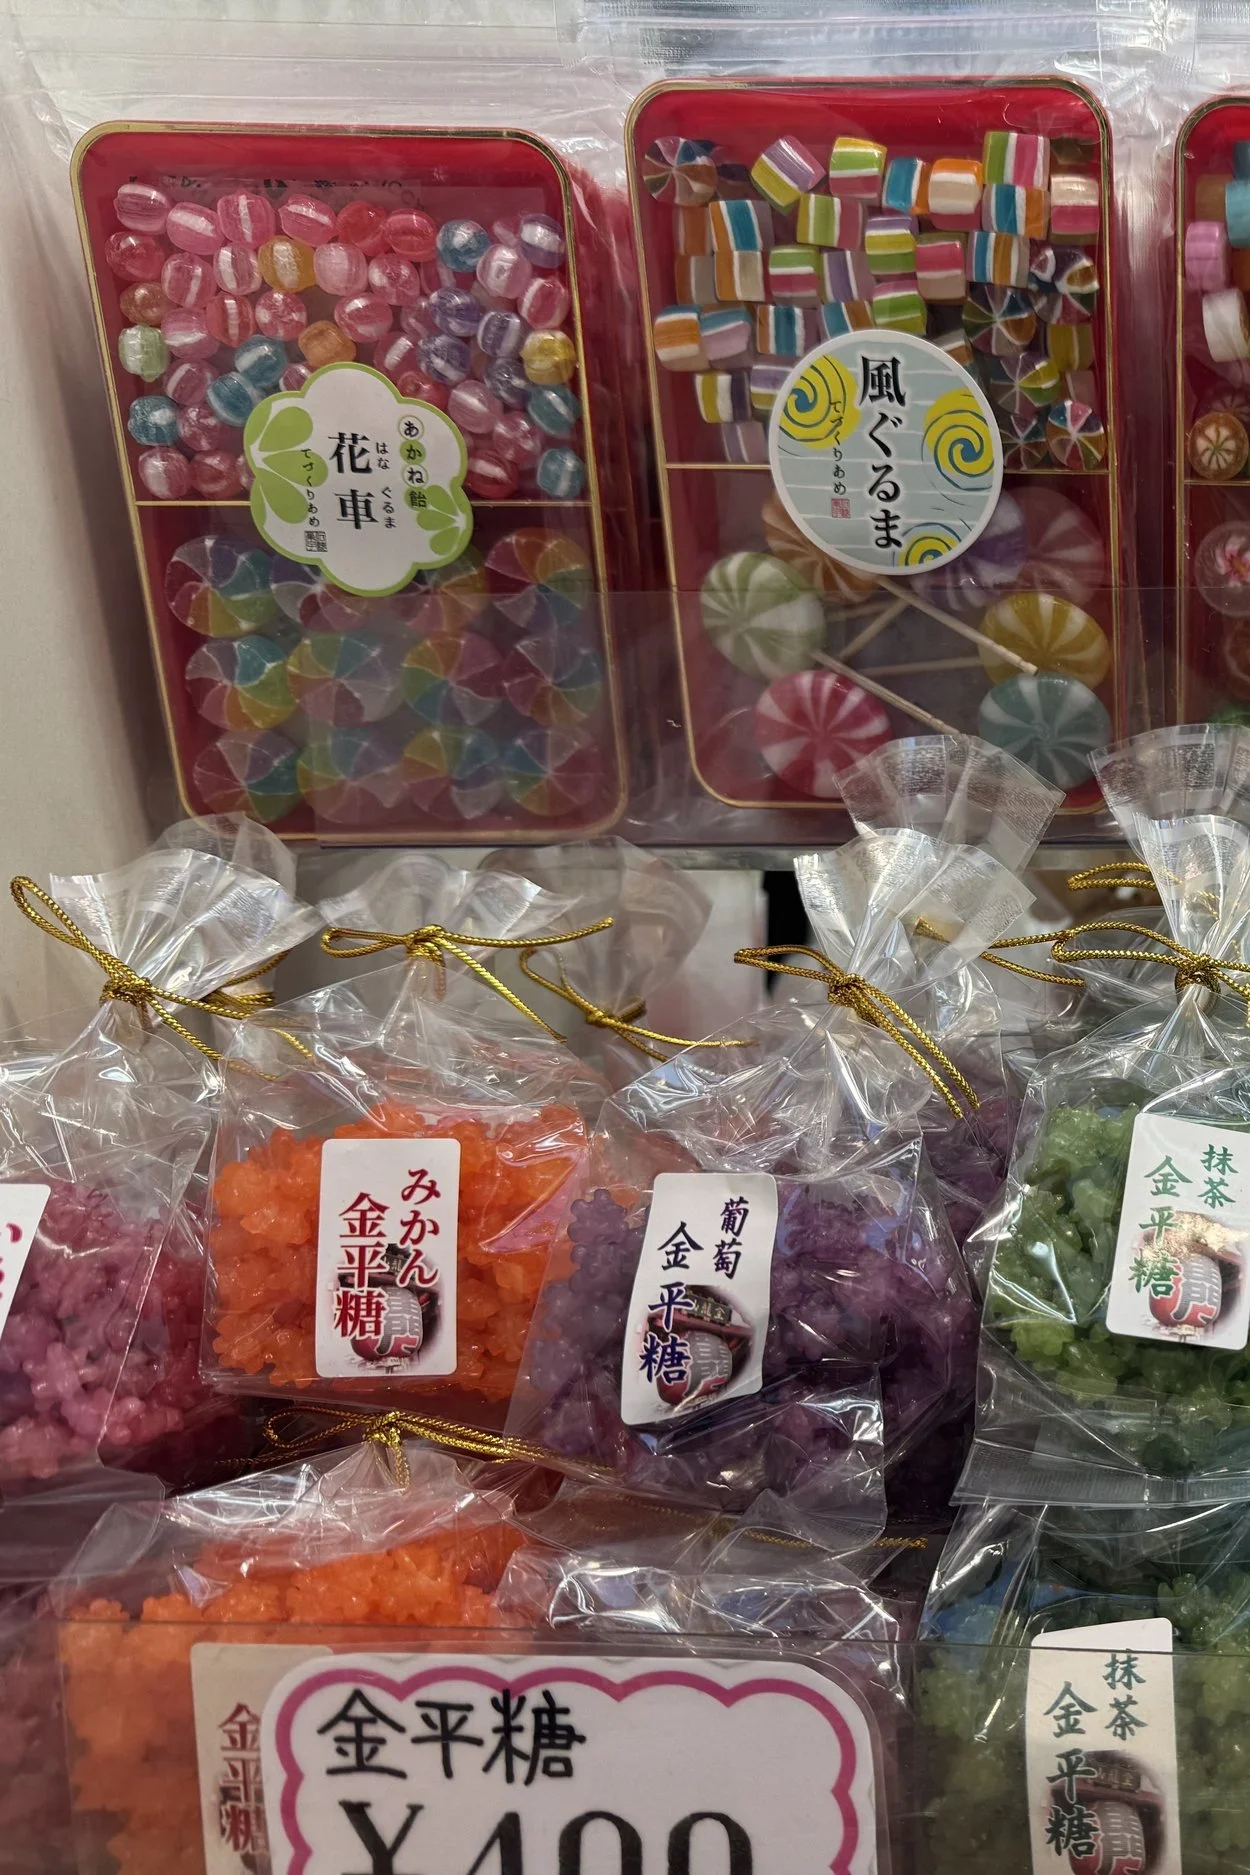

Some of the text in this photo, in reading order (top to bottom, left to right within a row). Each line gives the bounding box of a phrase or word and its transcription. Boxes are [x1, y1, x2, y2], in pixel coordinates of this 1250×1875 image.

[301, 447, 321, 528] てづくりあめ
[327, 431, 380, 530] 花車
[402, 419, 429, 511] あかね飴
[830, 400, 848, 496] てづくりあめ
[859, 355, 907, 549] 風ぐるま
[1197, 1143, 1240, 1210] 抹茶
[333, 1191, 391, 1338] 金平糖
[399, 1168, 442, 1288] みかん
[712, 1195, 751, 1280] 葡萄
[1128, 1155, 1193, 1298] 金平糖
[638, 1220, 705, 1385] 金平糖
[316, 1688, 587, 1786] 金平糖
[1101, 1647, 1149, 1742] 抹茶
[1043, 1680, 1100, 1858] 金平糖
